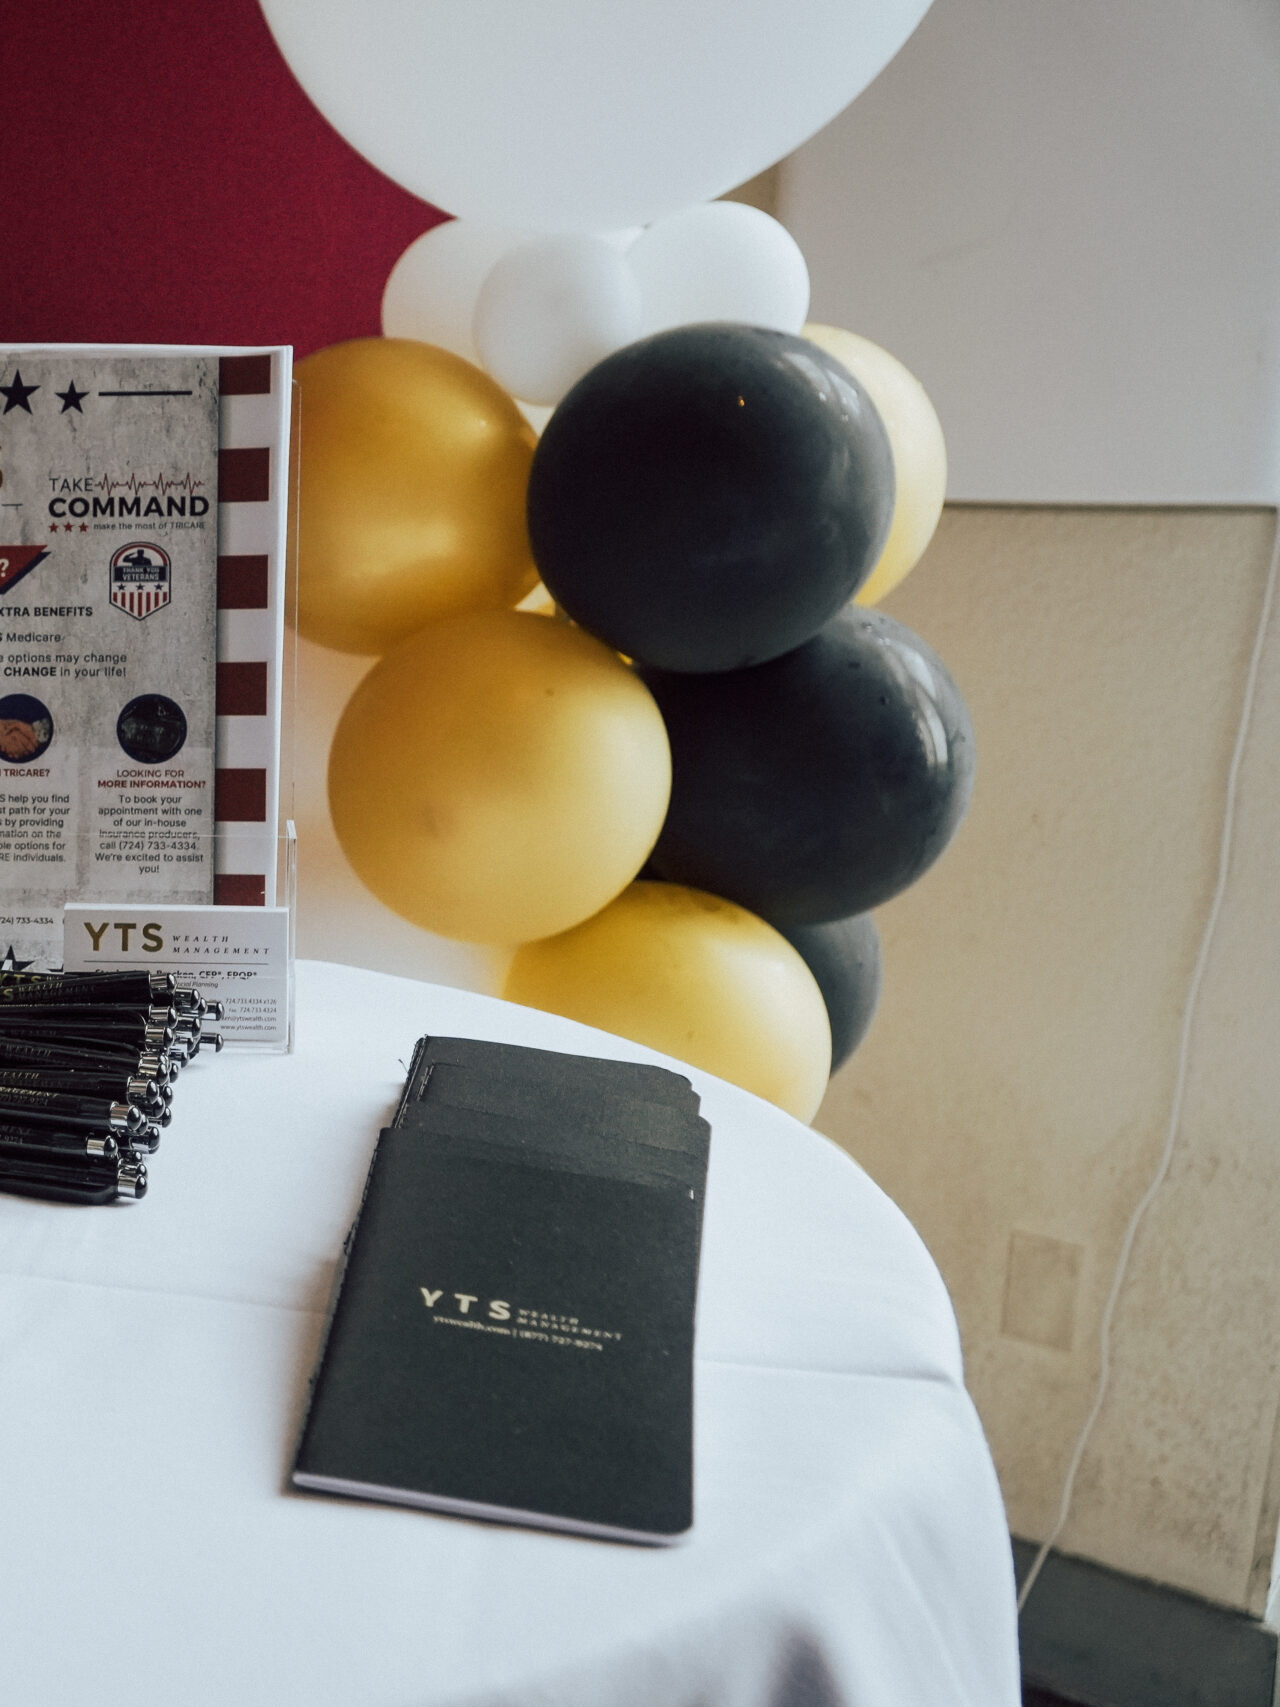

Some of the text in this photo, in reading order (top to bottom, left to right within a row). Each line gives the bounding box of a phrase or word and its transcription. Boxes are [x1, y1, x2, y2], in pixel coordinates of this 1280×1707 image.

[49, 478, 93, 492] TAKE
[48, 496, 209, 518] COMMAND
[123, 573, 160, 581] VETERANS
[34, 606, 92, 616] BENEFITS
[6, 632, 61, 642] Medicare
[8, 654, 51, 665] options
[56, 654, 79, 665] may
[84, 652, 127, 665] change
[4, 667, 56, 676] CHANGE
[60, 667, 70, 676] in
[74, 668, 100, 678] your
[104, 666, 126, 677] life!
[4, 769, 50, 777] TRICARE?
[117, 770, 161, 778] LOOKING
[98, 780, 206, 788] MORE INFORMATION?
[8, 794, 29, 804] help
[32, 796, 48, 804] you
[51, 794, 69, 803] find
[120, 795, 182, 805] To book your
[9, 806, 30, 815] path
[33, 806, 46, 814] for
[49, 808, 70, 816] your
[98, 807, 158, 816] appointment
[161, 807, 181, 815] with
[5, 818, 16, 827] by
[20, 818, 64, 828] providing
[113, 818, 186, 827] of our in-house
[46, 830, 61, 838] the
[14, 842, 49, 851] options
[52, 842, 66, 850] for
[100, 841, 144, 851] call (724)
[13, 853, 65, 862] individuals.
[95, 853, 122, 861] We're
[125, 853, 160, 861] excited
[176, 853, 203, 862] assist
[139, 865, 159, 874] you!
[83, 922, 163, 952] YTS
[173, 935, 229, 943] WEALTH
[173, 947, 269, 955] MANAGEMENT
[19, 983, 63, 993] WEALTH
[6, 1044, 51, 1057] WEALTH
[420, 1287, 579, 1325] YTS WEALTH
[517, 1317, 622, 1341] MANAGEMENT
